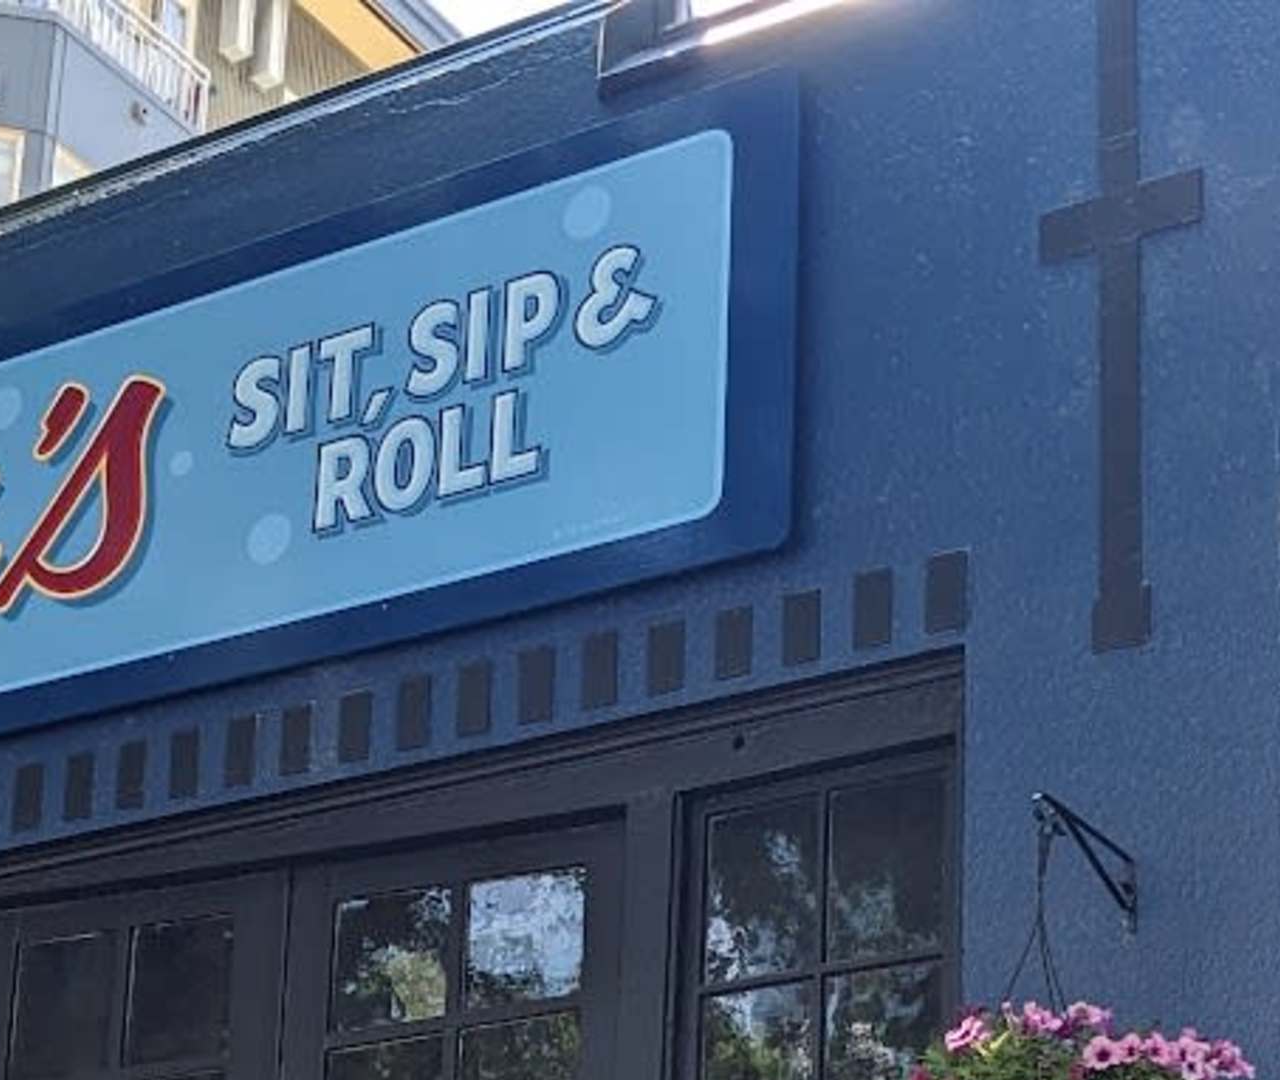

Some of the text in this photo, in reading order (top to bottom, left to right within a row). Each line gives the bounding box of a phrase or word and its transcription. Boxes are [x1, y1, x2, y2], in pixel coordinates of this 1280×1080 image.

[226, 243, 660, 452] SIT, SIP &
[311, 389, 546, 536] ROLL
